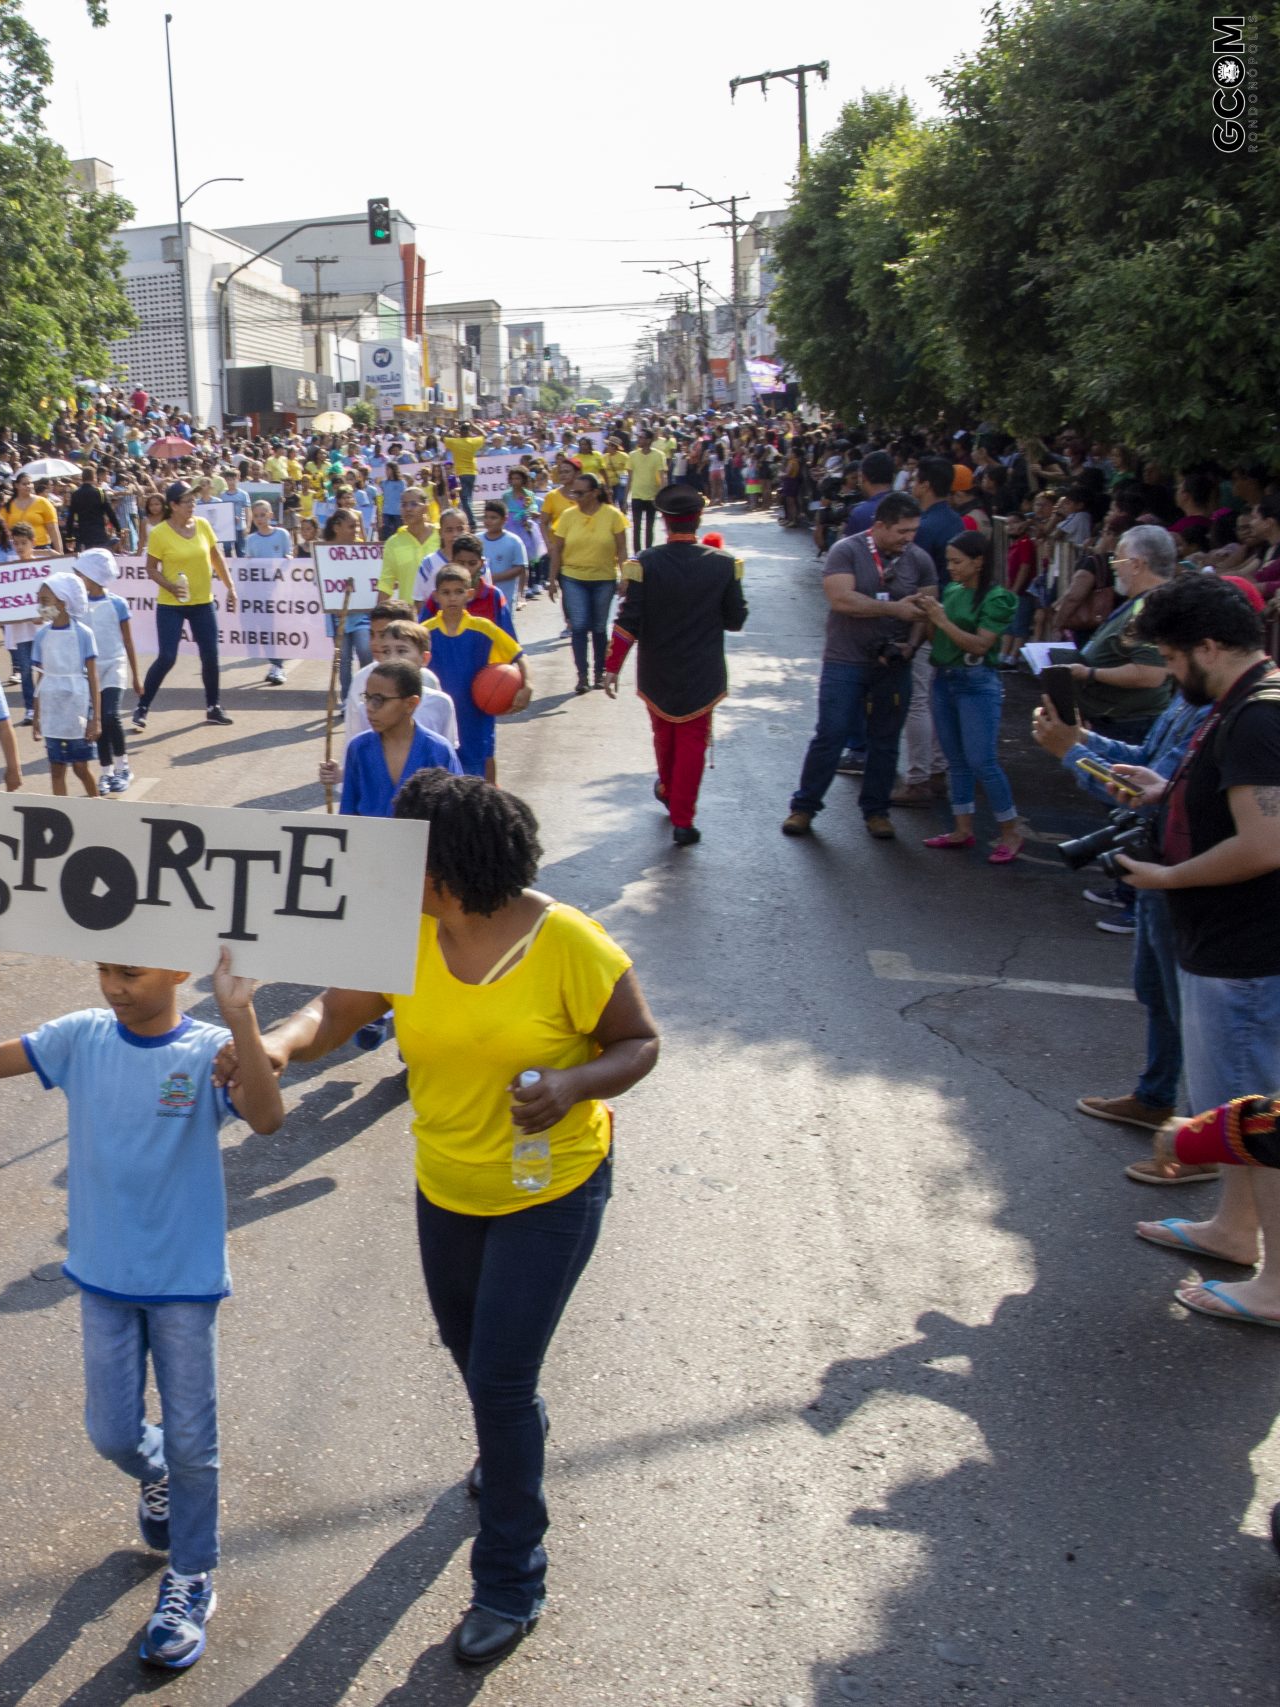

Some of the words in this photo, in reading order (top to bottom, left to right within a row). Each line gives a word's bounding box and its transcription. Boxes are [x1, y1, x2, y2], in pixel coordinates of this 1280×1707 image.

[238, 567, 285, 582] BELA
[241, 599, 321, 614] PRECISO
[229, 630, 309, 650] RIBEIRO)
